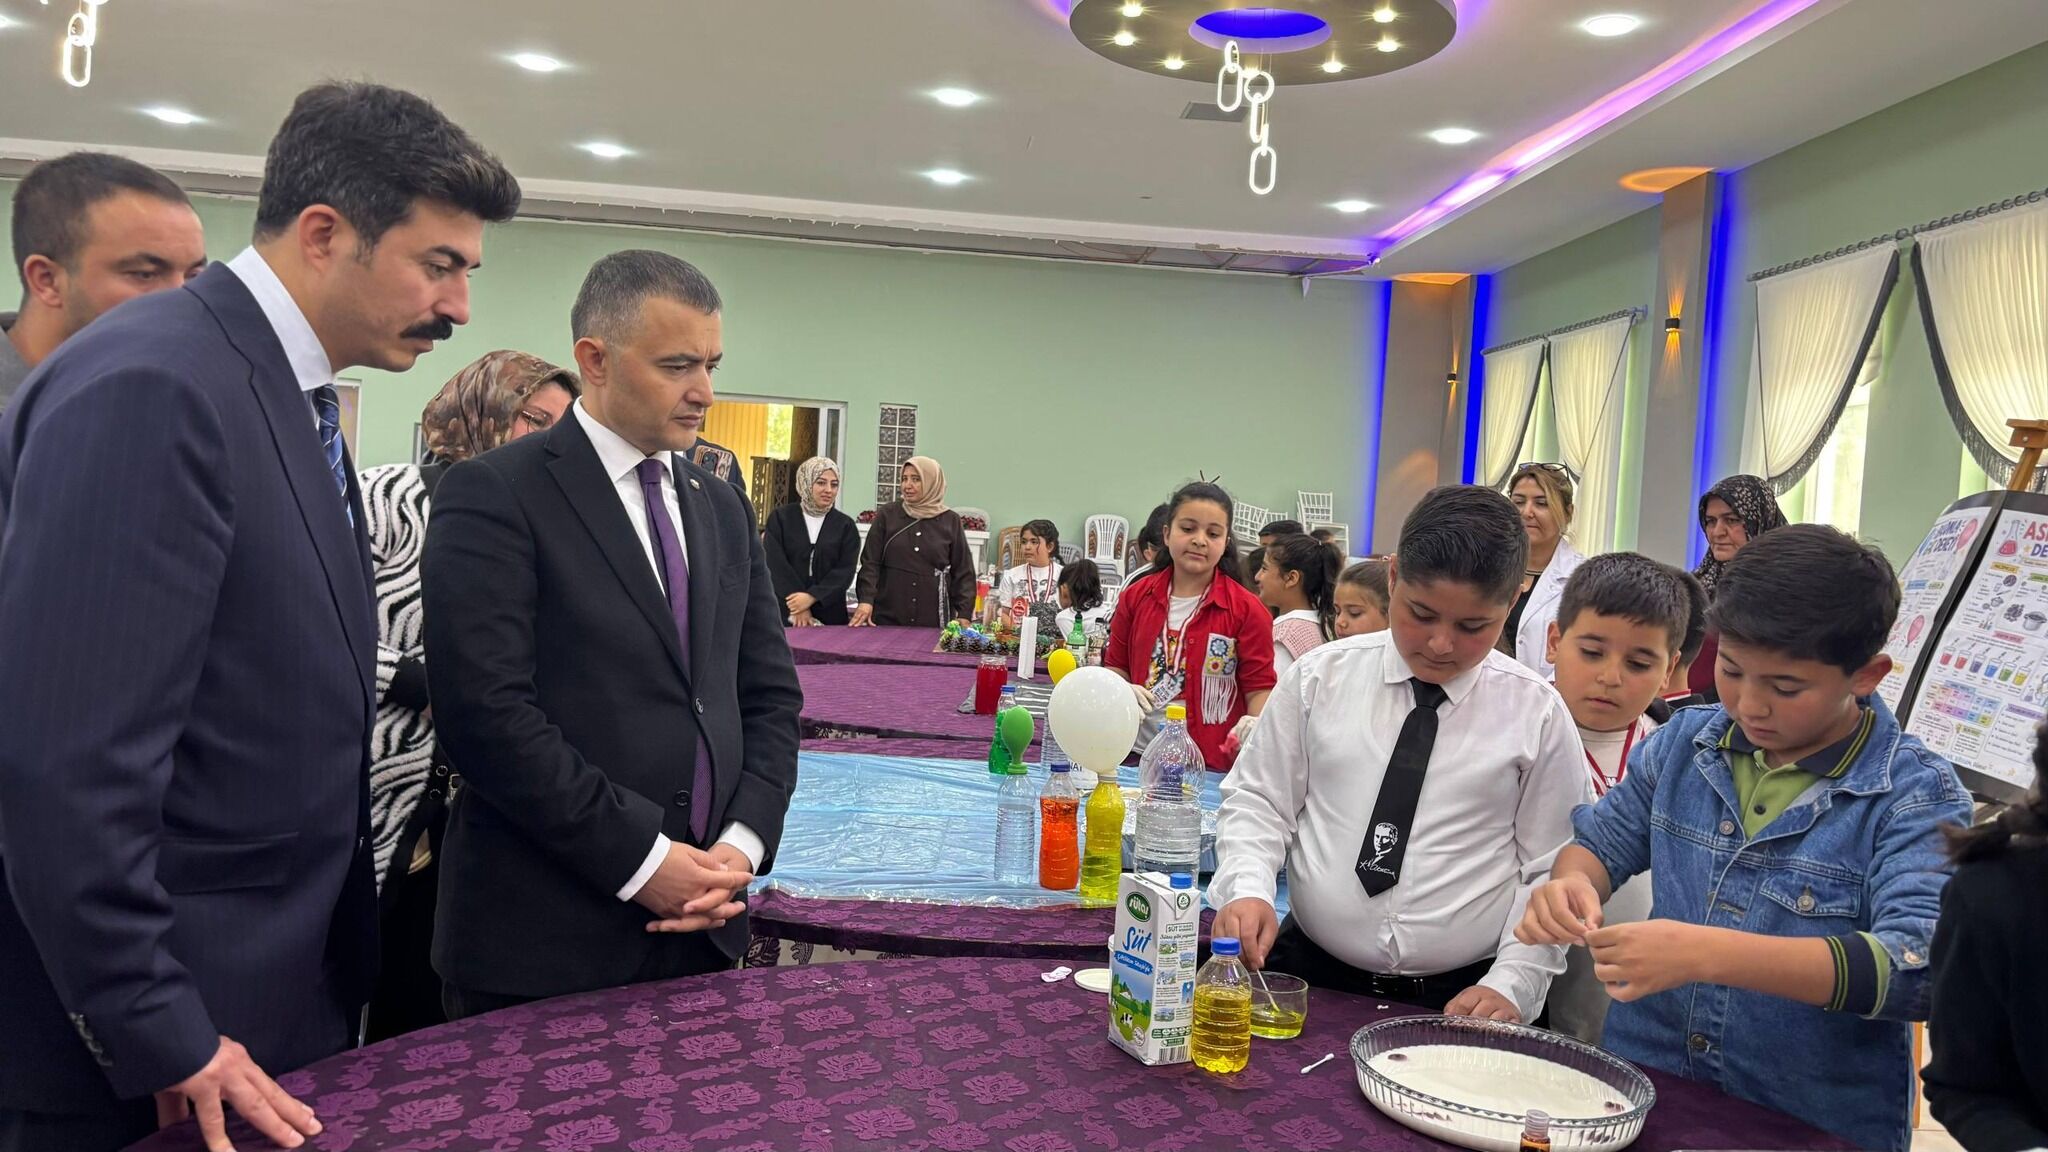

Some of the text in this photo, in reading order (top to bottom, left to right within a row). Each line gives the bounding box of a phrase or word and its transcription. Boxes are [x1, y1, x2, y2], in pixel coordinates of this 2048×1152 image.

[2022, 520, 2048, 542] AS
[2030, 543, 2048, 558] DE
[1122, 926, 1152, 954] Süt
